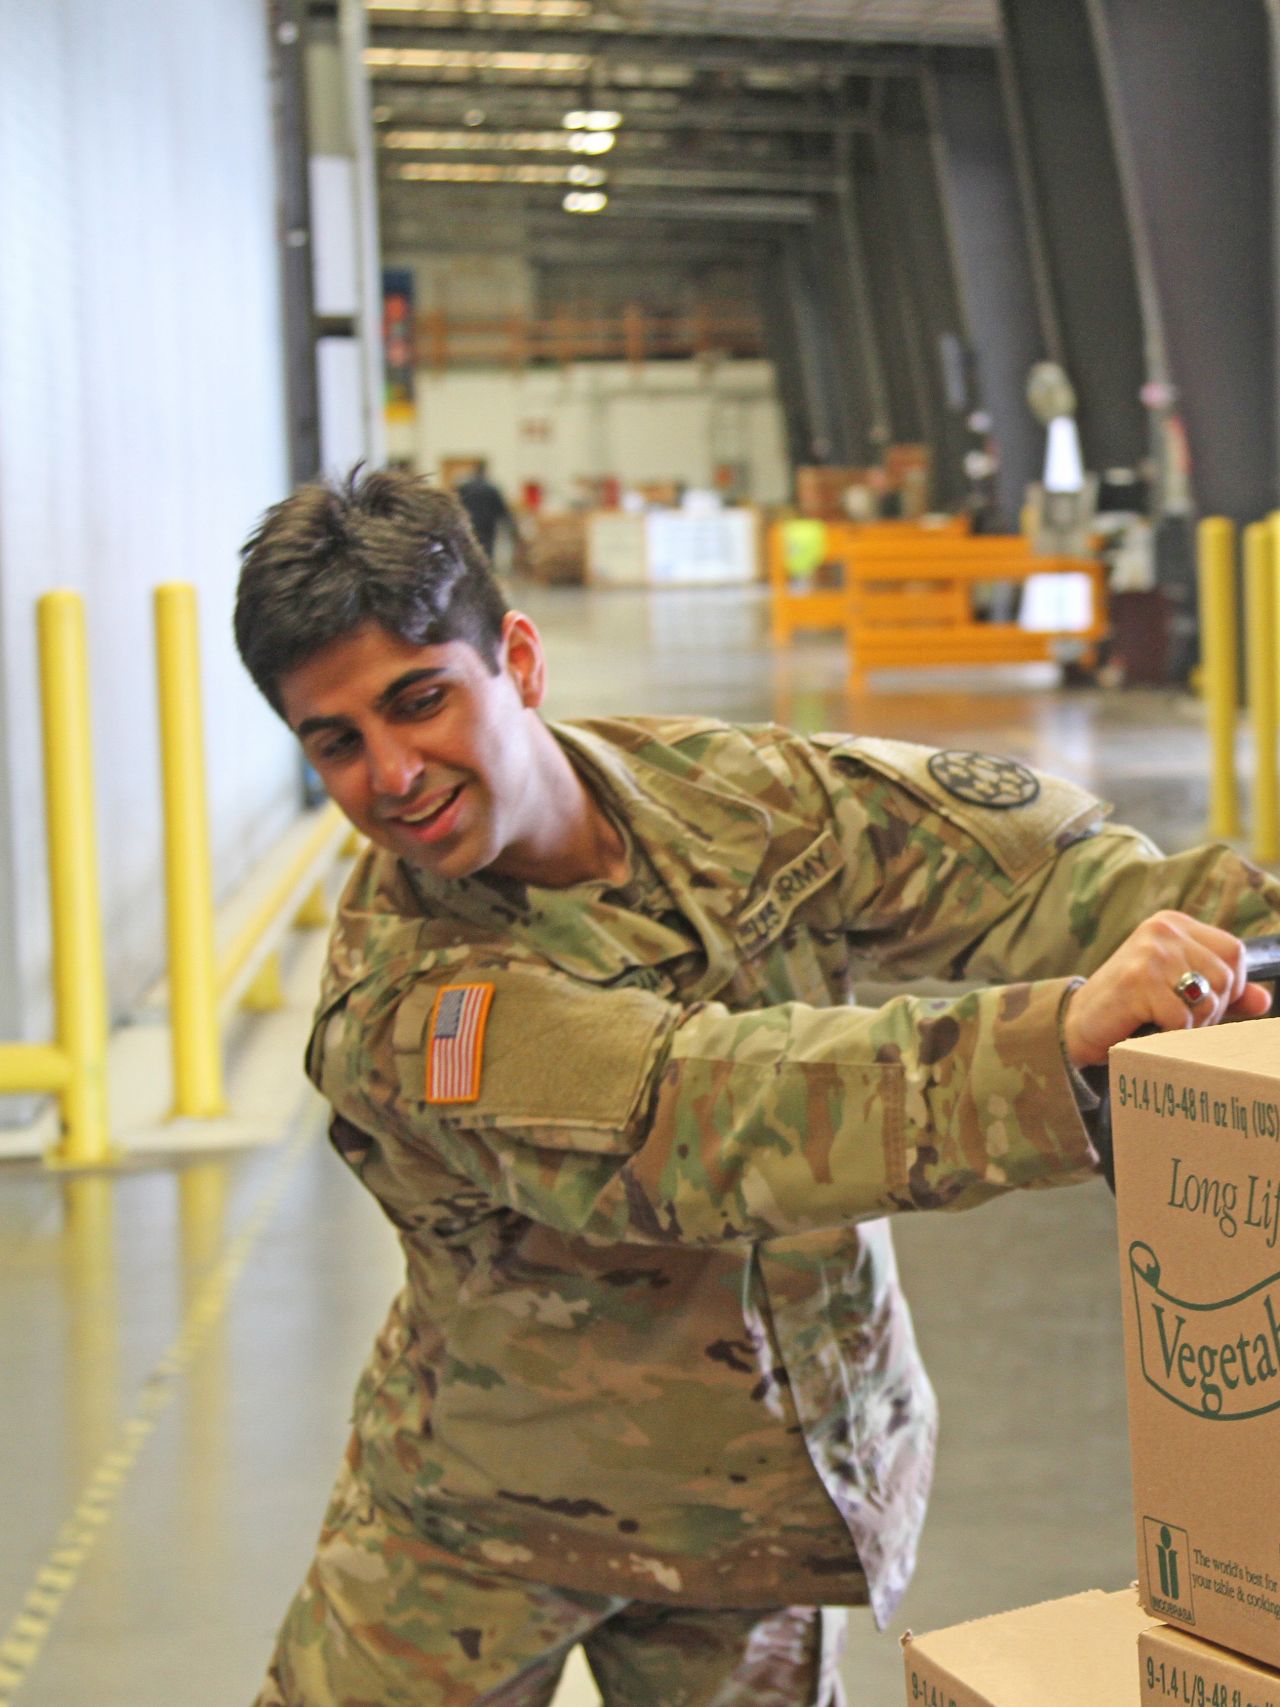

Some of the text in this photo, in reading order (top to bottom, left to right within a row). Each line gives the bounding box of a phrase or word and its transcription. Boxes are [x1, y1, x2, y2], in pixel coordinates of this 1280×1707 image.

[1119, 1074, 1280, 1142] 9-1.4 L/9-48 fl oz liq (US)
[1168, 1157, 1239, 1239] Long
